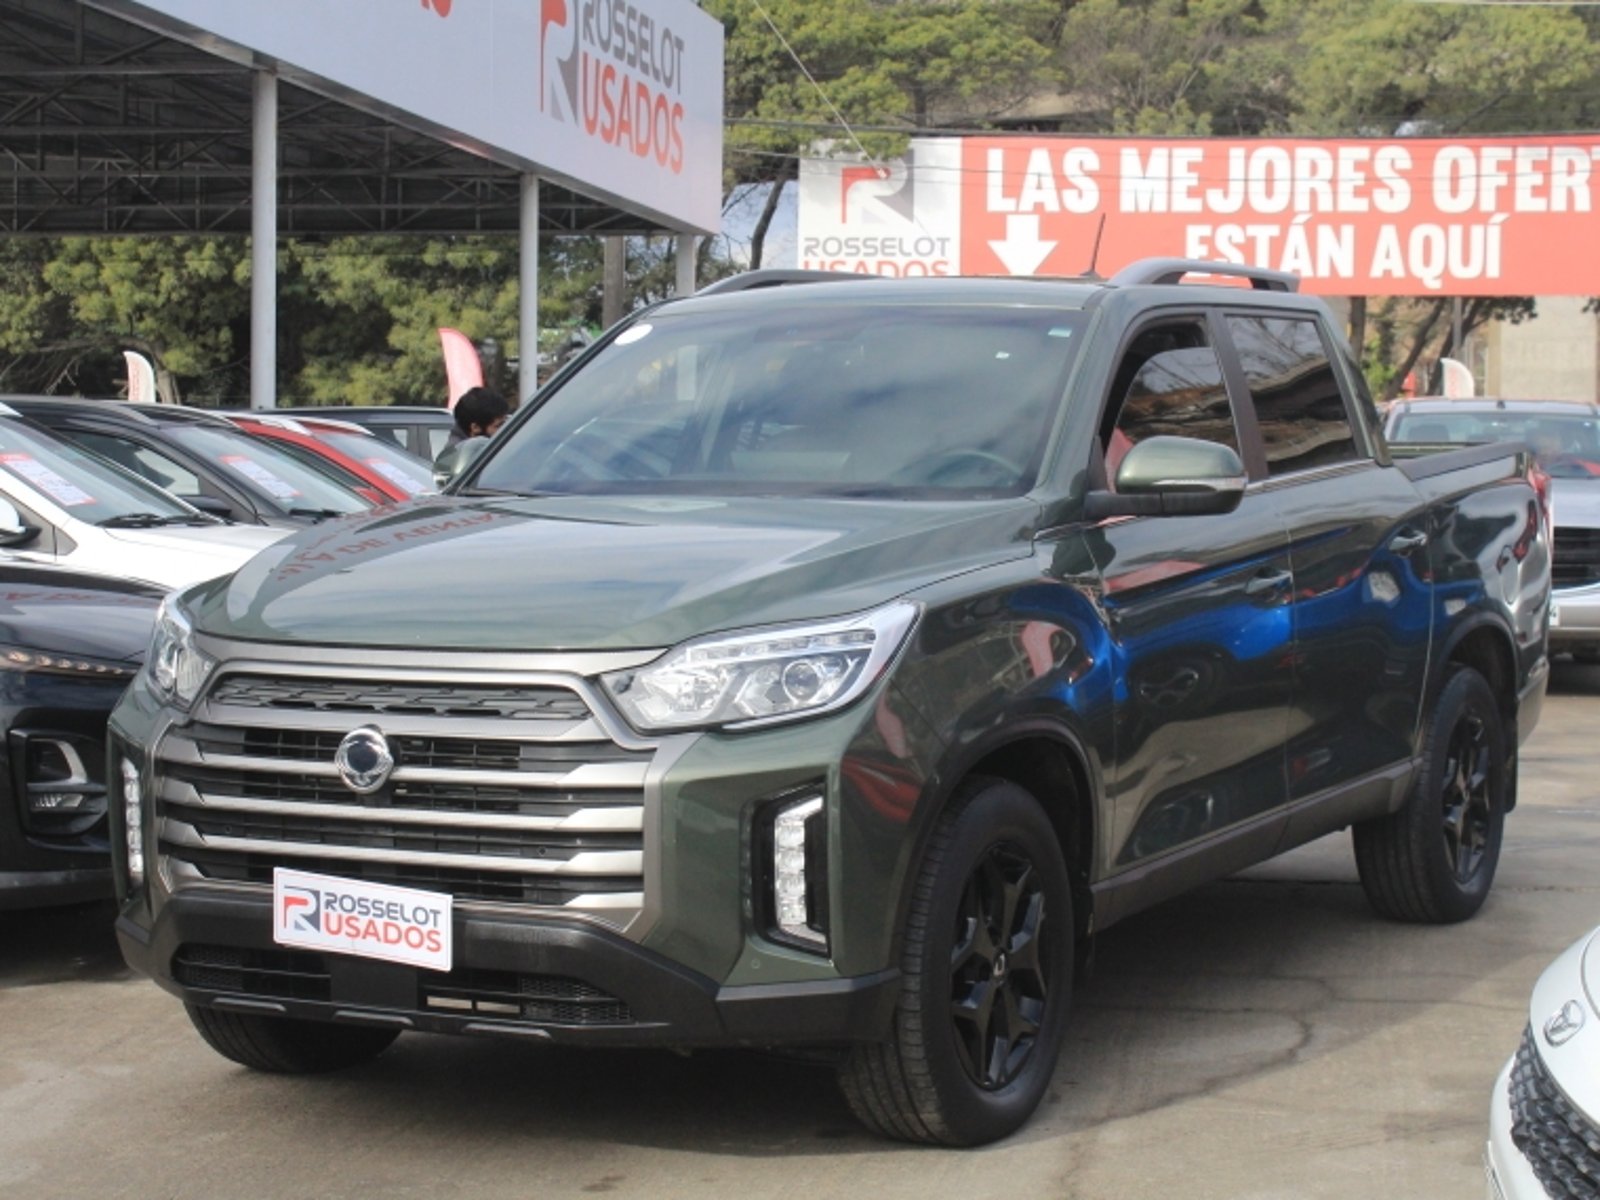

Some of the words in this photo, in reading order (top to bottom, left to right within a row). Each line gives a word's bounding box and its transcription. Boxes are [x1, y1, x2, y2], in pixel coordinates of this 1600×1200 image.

[582, 0, 685, 95] ROSSELOT
[582, 50, 684, 174] USADOS
[986, 147, 1100, 214] LAS
[1119, 145, 1413, 214] MEJORES
[1432, 144, 1600, 213] OFER
[803, 236, 951, 258] ROSSELOT
[1186, 213, 1355, 278] ESTÁN
[1370, 213, 1511, 289] AQUÍ
[324, 892, 441, 928] ROSSELOT
[324, 912, 442, 953] USADOS
